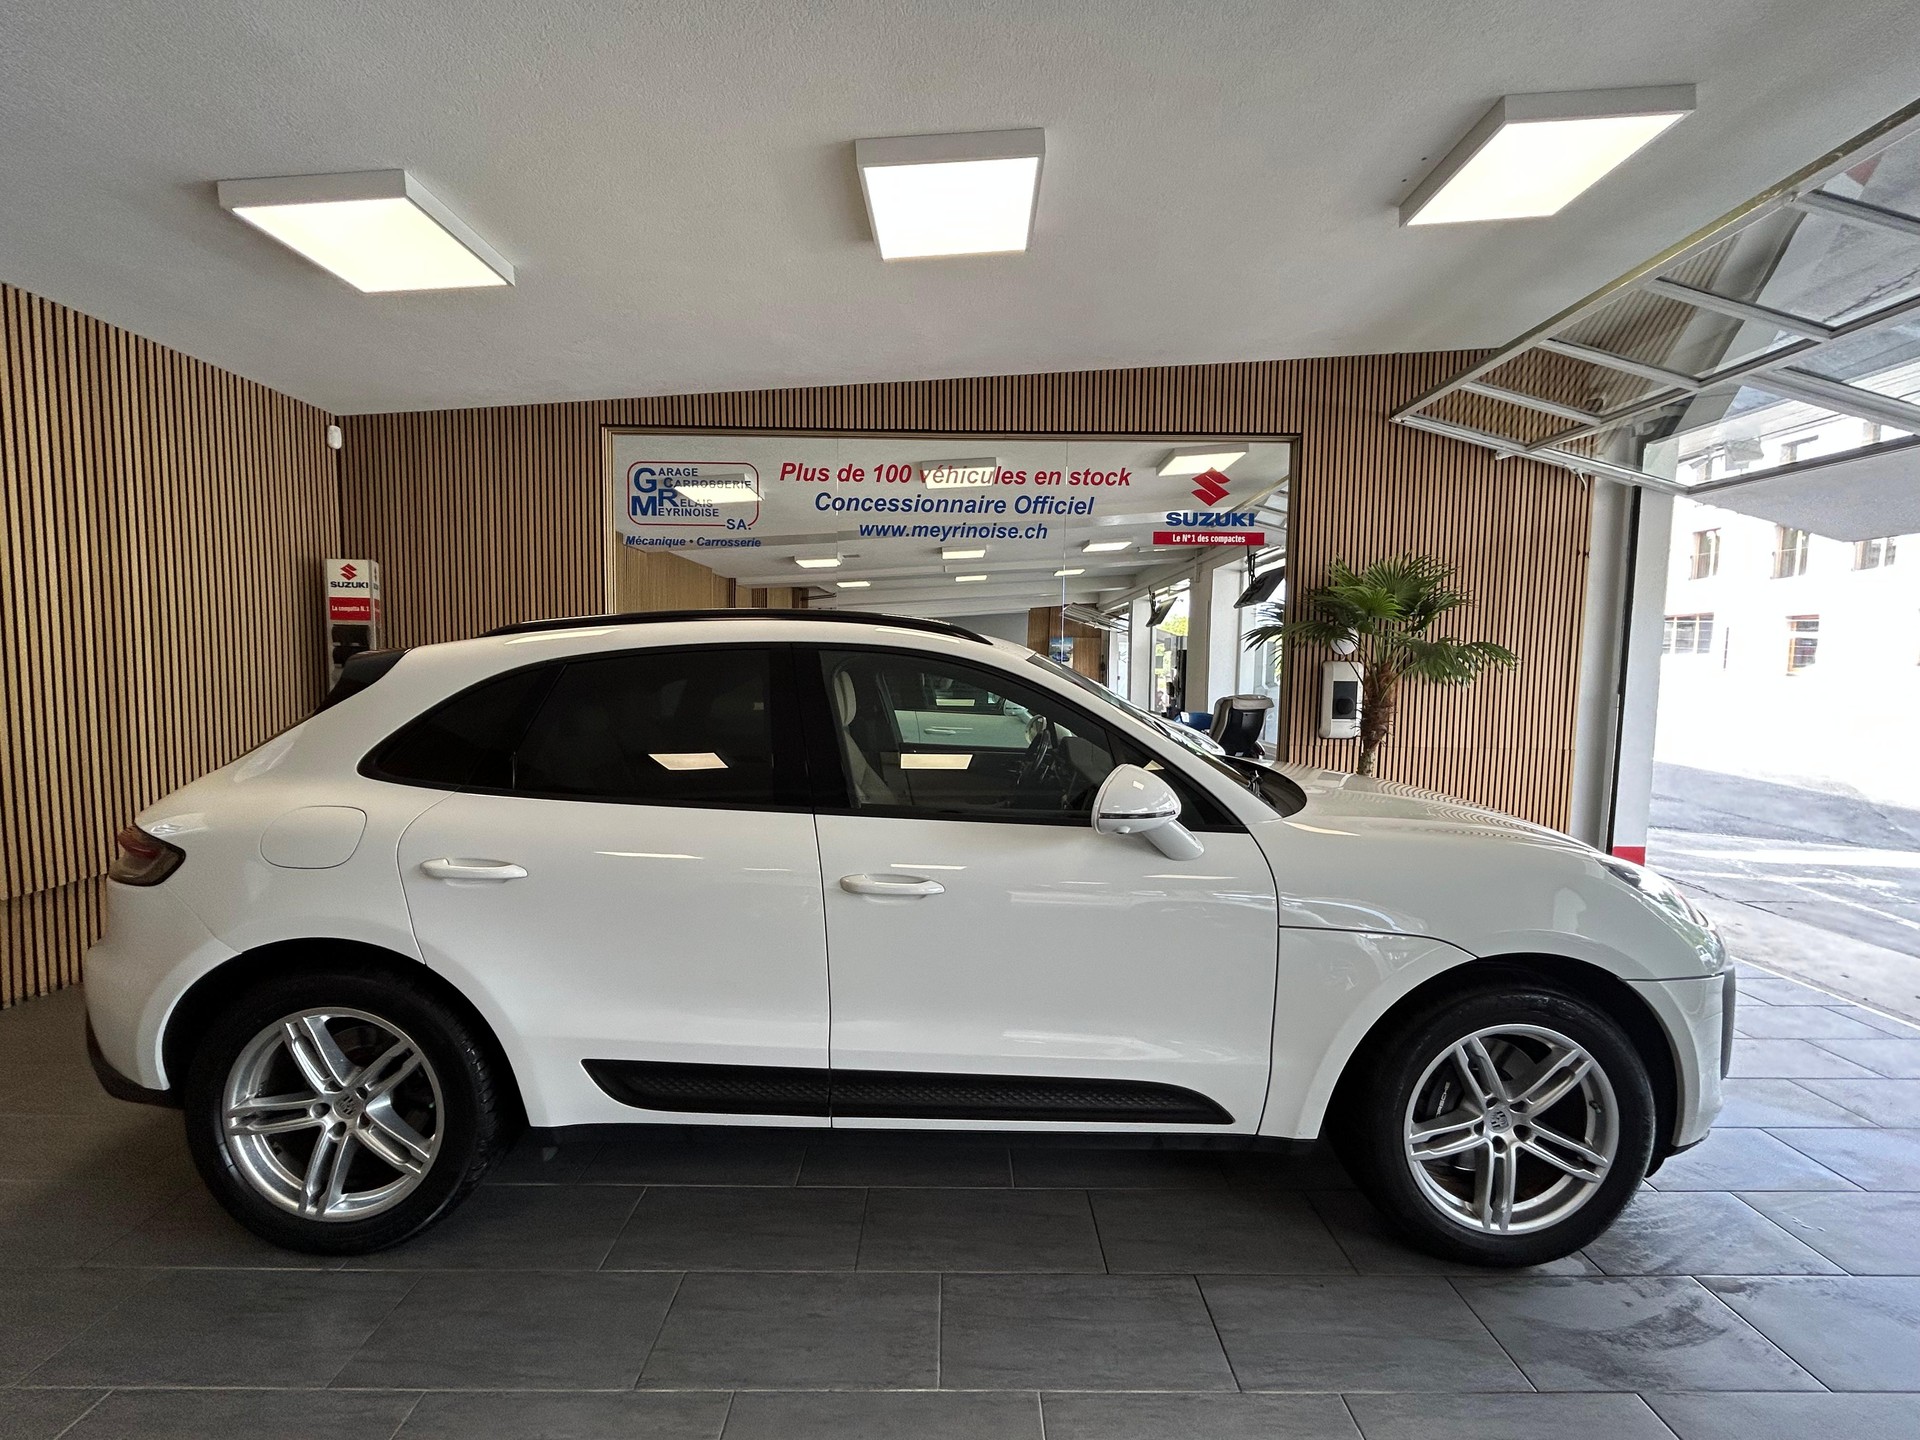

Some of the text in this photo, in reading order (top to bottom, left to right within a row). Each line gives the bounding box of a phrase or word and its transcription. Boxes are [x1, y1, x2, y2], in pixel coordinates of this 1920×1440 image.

[633, 467, 699, 493] GARAGE
[779, 462, 1132, 486] Plus de 100 véhicules en stock
[663, 477, 752, 489] CARROSSERIE
[631, 496, 719, 517] MEYRINOISE
[815, 492, 1094, 515] Concessionnaire Officiel
[1165, 512, 1255, 527] SUZUKI
[859, 524, 1048, 541] www.meyrinoise.ch
[1172, 534, 1181, 543] Le
[1197, 534, 1210, 544] des
[1210, 535, 1246, 544] compactes
[626, 536, 762, 548] Mécanique Carrosserie
